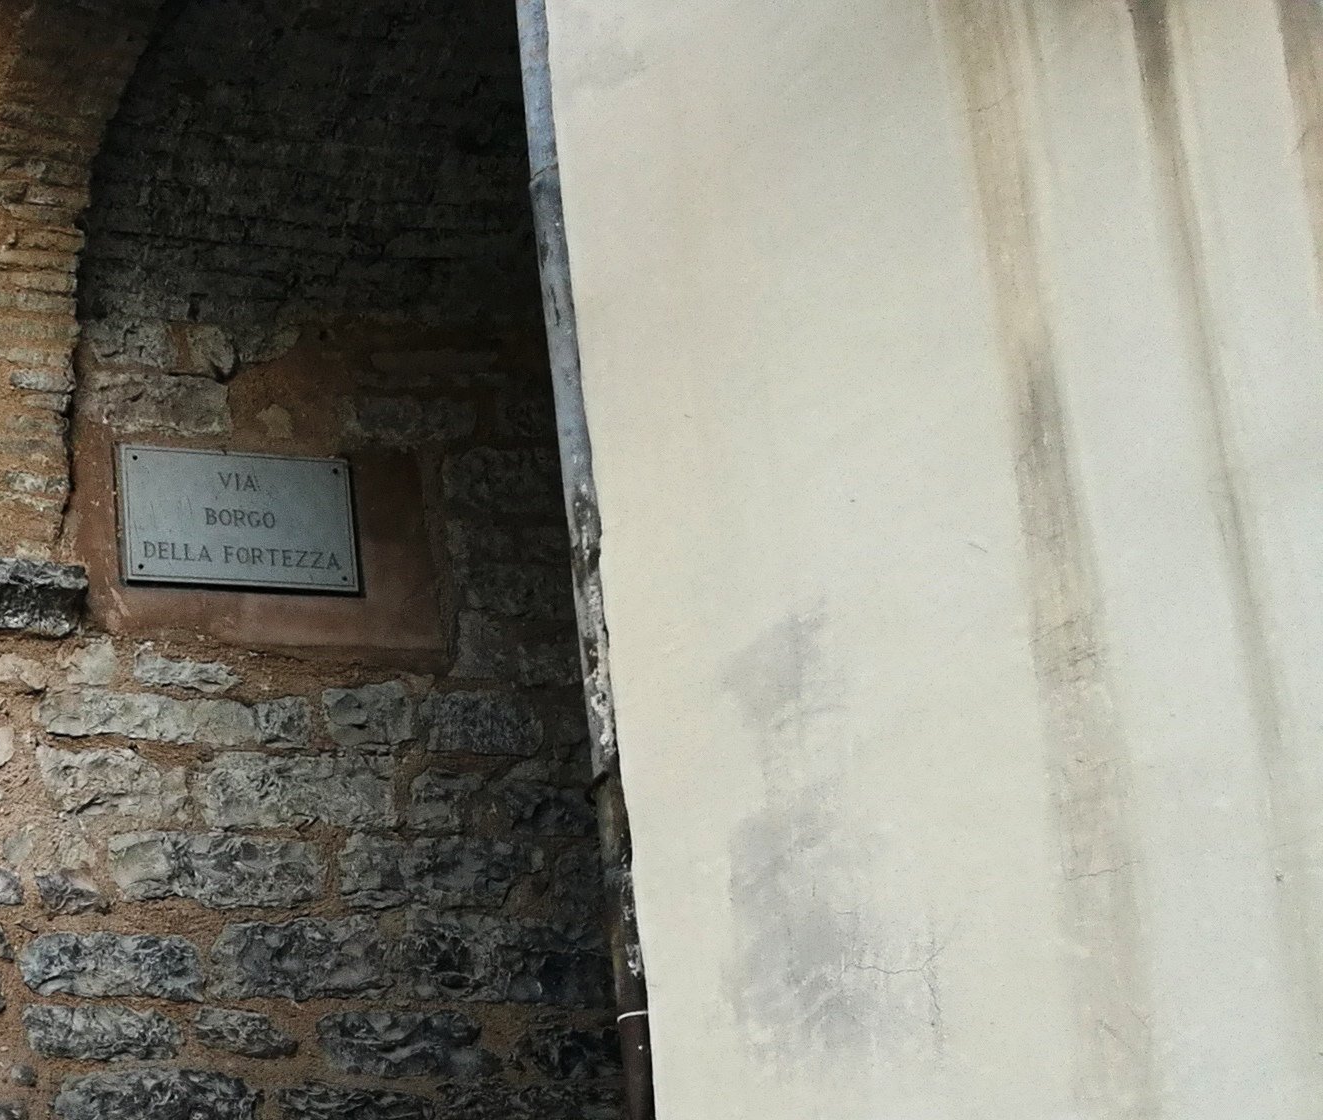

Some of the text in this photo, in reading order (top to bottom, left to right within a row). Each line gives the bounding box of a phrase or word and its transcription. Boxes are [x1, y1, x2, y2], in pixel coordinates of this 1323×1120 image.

[217, 471, 260, 492] VIA
[204, 507, 277, 530] BORGO
[143, 540, 343, 572] DELLA FORTEZZA
